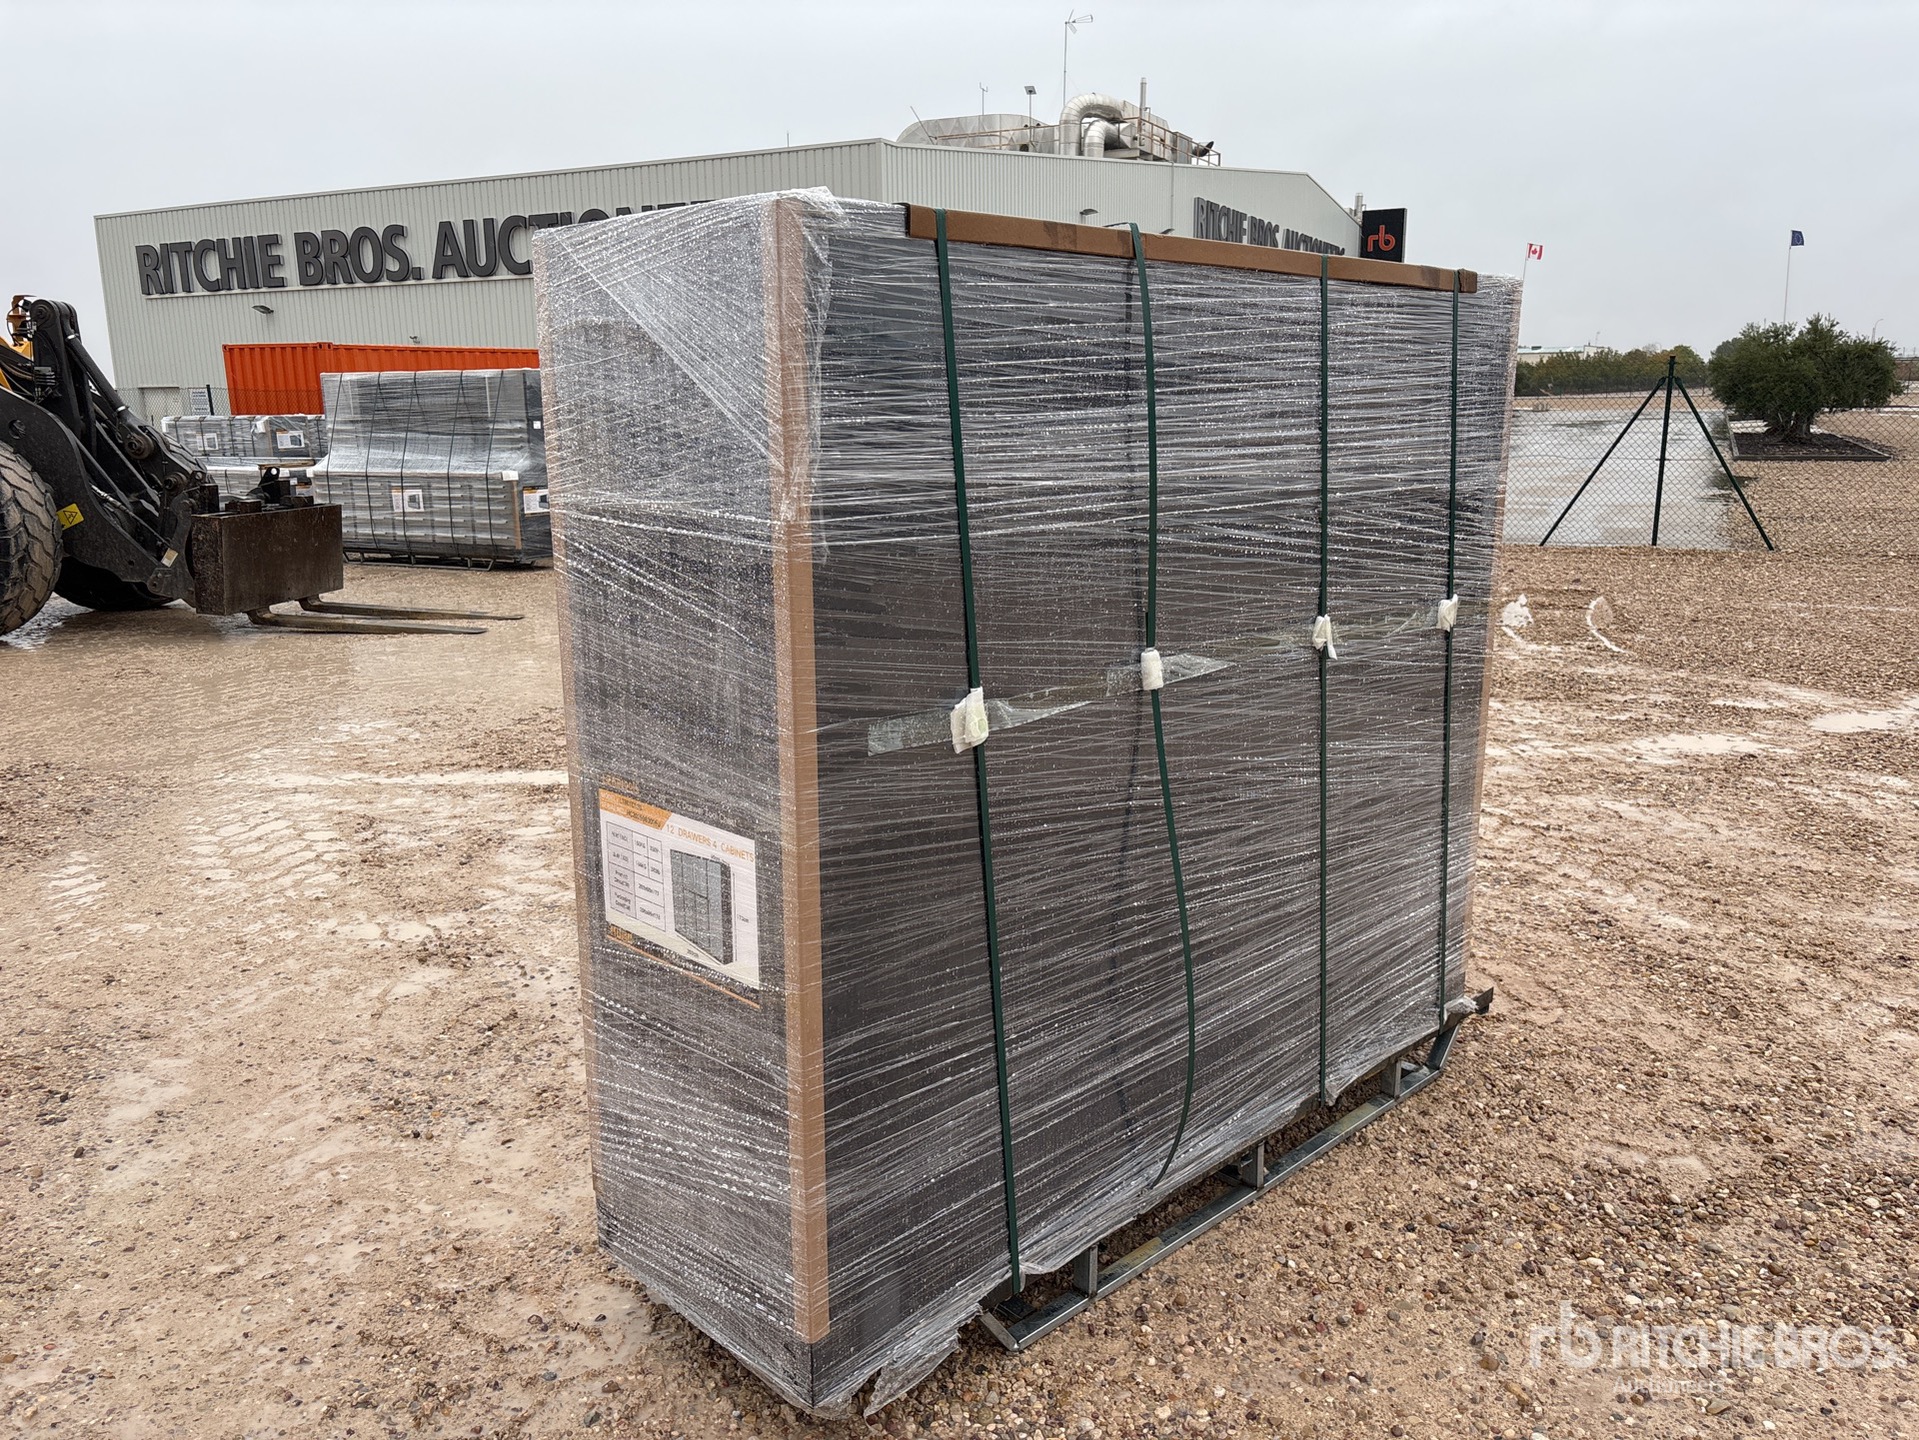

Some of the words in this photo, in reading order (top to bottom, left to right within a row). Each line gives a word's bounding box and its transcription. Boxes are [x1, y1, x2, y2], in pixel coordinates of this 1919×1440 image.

[1193, 197, 1247, 244] RITCHIE
[1367, 224, 1396, 253] rb
[135, 232, 286, 295] RITCHIE
[293, 223, 424, 286] BROS.
[666, 824, 675, 835] 12
[678, 828, 712, 847] DRAWERS
[720, 842, 755, 863] CABINETS
